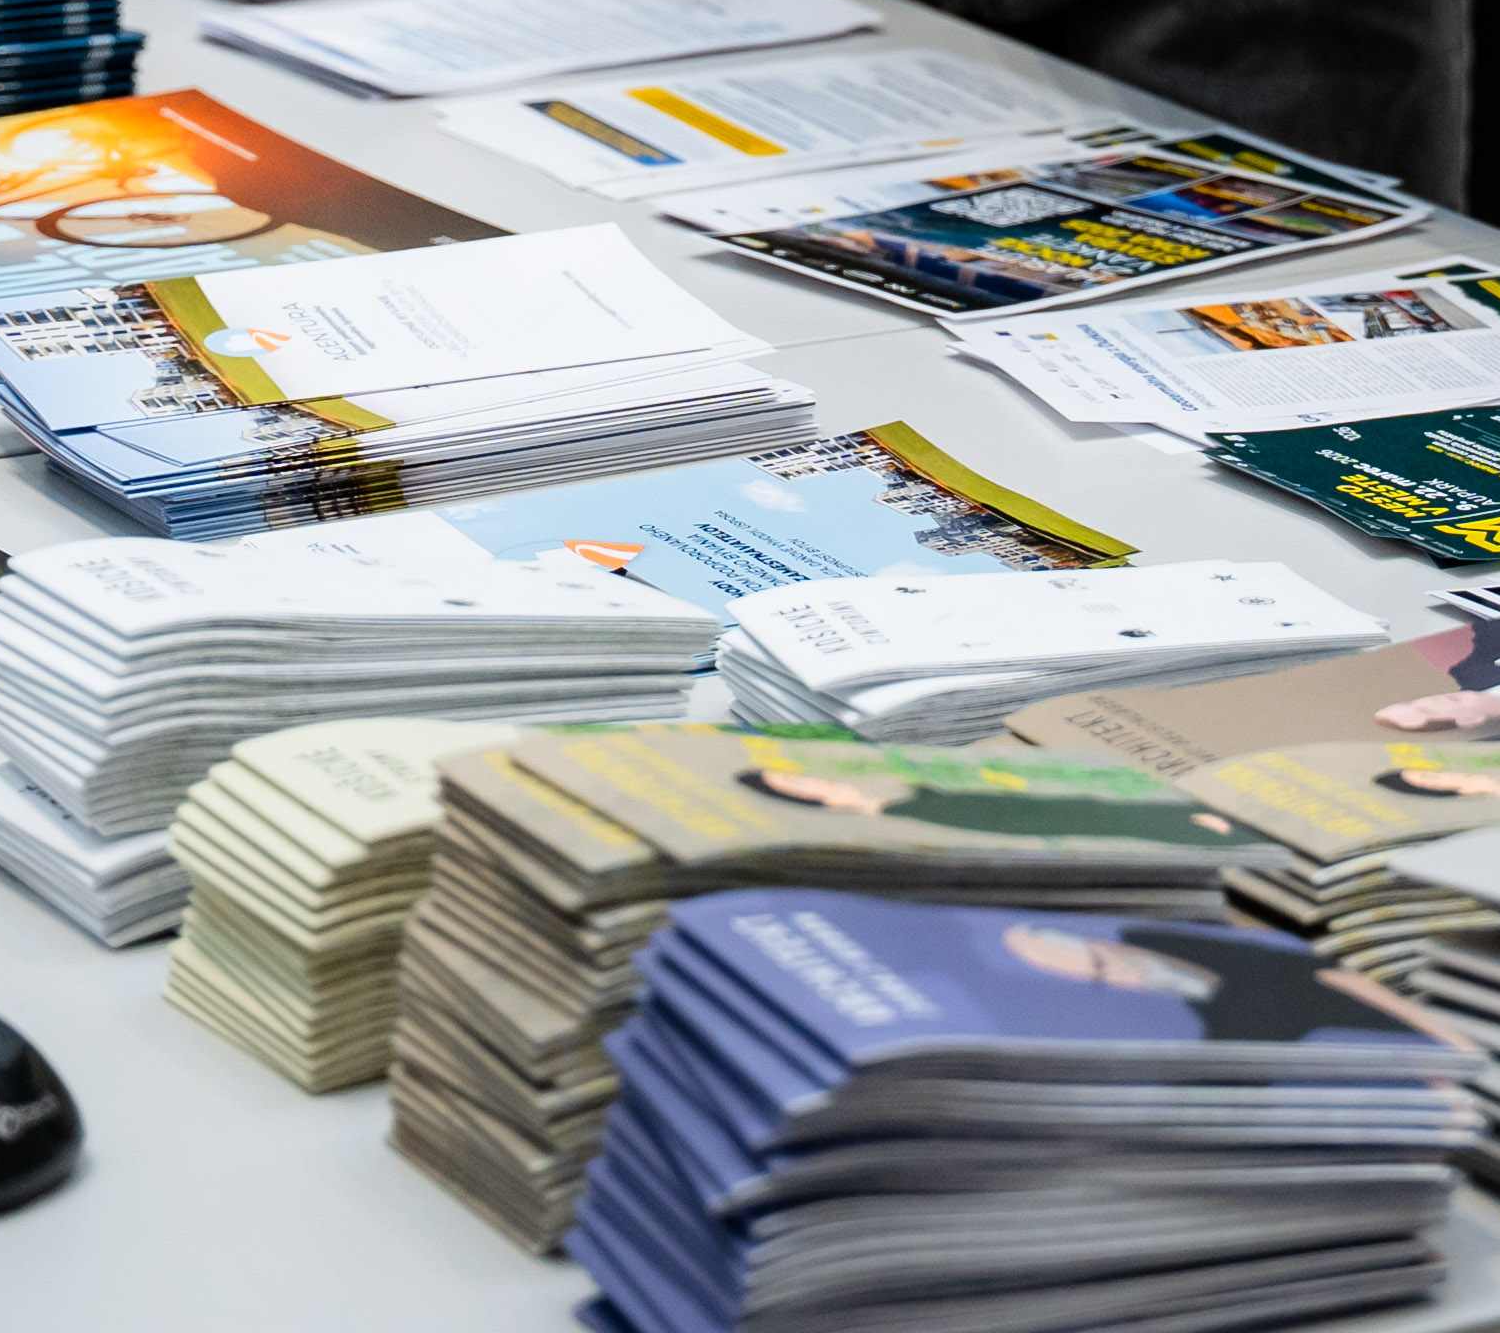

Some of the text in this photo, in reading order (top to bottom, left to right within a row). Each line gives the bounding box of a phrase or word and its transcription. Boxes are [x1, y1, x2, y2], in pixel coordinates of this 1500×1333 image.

[272, 301, 357, 362] AGENTÚRA
[1311, 448, 1363, 464] 2026
[1346, 462, 1420, 486] marec
[1331, 483, 1429, 518] MESTO
[1337, 473, 1456, 515] V MESTE
[1403, 484, 1450, 498] 22.
[1442, 500, 1482, 511] 9.
[634, 522, 745, 579] PODPOROVANÉHO
[770, 603, 854, 654] KOŠICKÉ
[827, 601, 890, 645] CINTORÍNY
